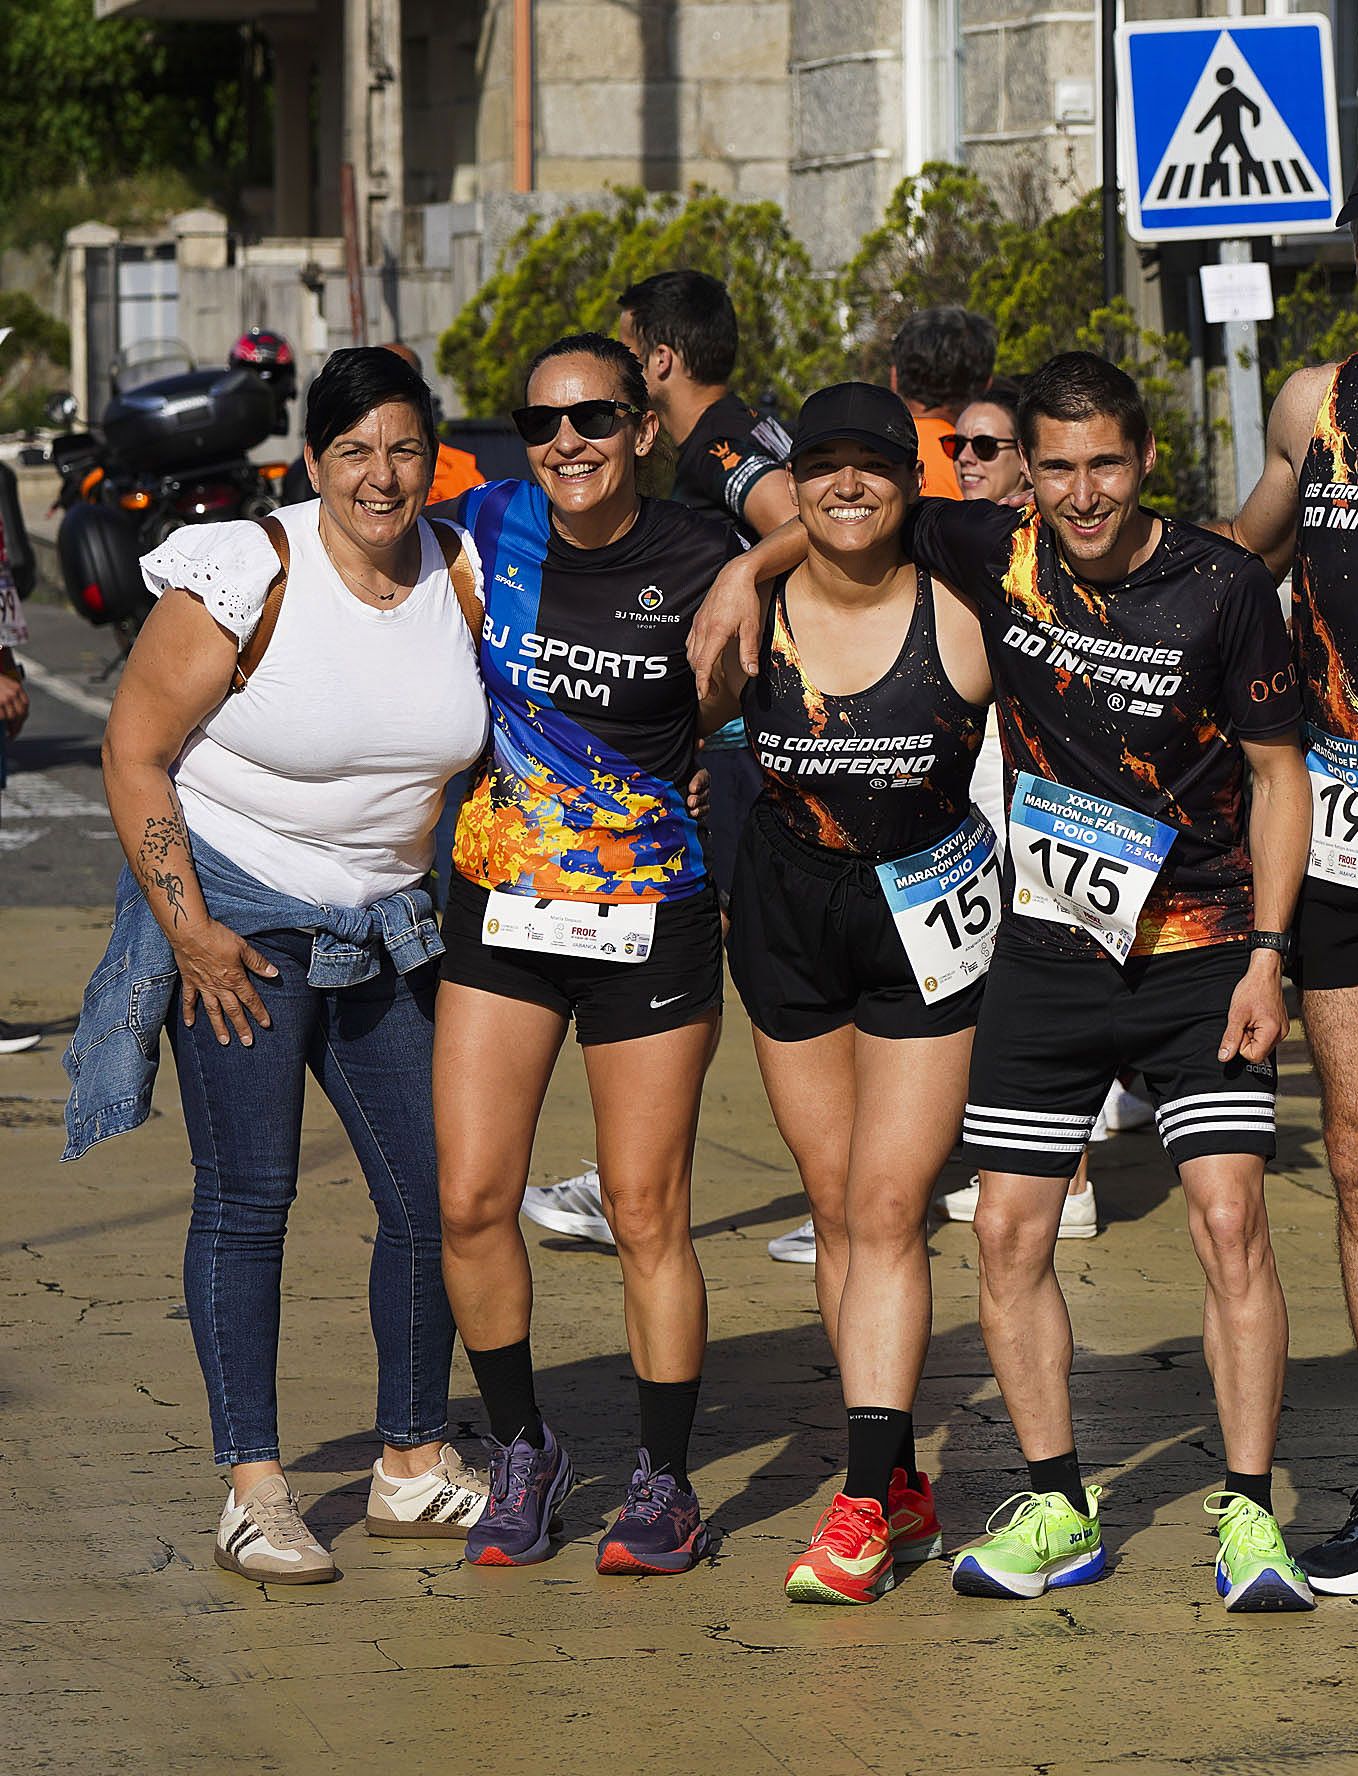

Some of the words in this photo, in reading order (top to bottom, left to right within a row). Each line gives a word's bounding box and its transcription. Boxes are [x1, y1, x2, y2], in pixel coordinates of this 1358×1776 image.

[1304, 483, 1322, 498] OS
[1303, 507, 1325, 528] DO
[628, 612, 681, 623] TRAINERS
[482, 613, 511, 648] BJ
[518, 632, 669, 680] SPORTS
[1002, 625, 1047, 657] DO
[1045, 642, 1183, 697] INFERNO
[505, 661, 611, 707] TEAM
[1127, 699, 1165, 718] 25
[757, 731, 781, 748] OS
[783, 734, 934, 753] CORREDORES
[1324, 736, 1357, 755] XXXVII
[760, 751, 792, 773] DO
[797, 754, 936, 775] INFERNO
[1339, 757, 1348, 767] DE
[890, 777, 924, 788] 25
[1067, 793, 1113, 818] XXXVII
[1024, 793, 1082, 821] MARATÓN
[1081, 815, 1095, 826] DE
[1094, 817, 1153, 848] FÁTIMA
[1052, 819, 1098, 845] POIO
[930, 831, 966, 861] XXXVII
[1124, 843, 1142, 857] 7.5
[1143, 851, 1164, 865] KM
[895, 857, 954, 890] MARATÓN
[952, 851, 963, 863] DE
[1338, 855, 1357, 866] FROIZ
[938, 858, 974, 891] POIO
[1028, 837, 1129, 916] 175
[924, 860, 1000, 951] 157
[571, 926, 597, 938] FROIZ
